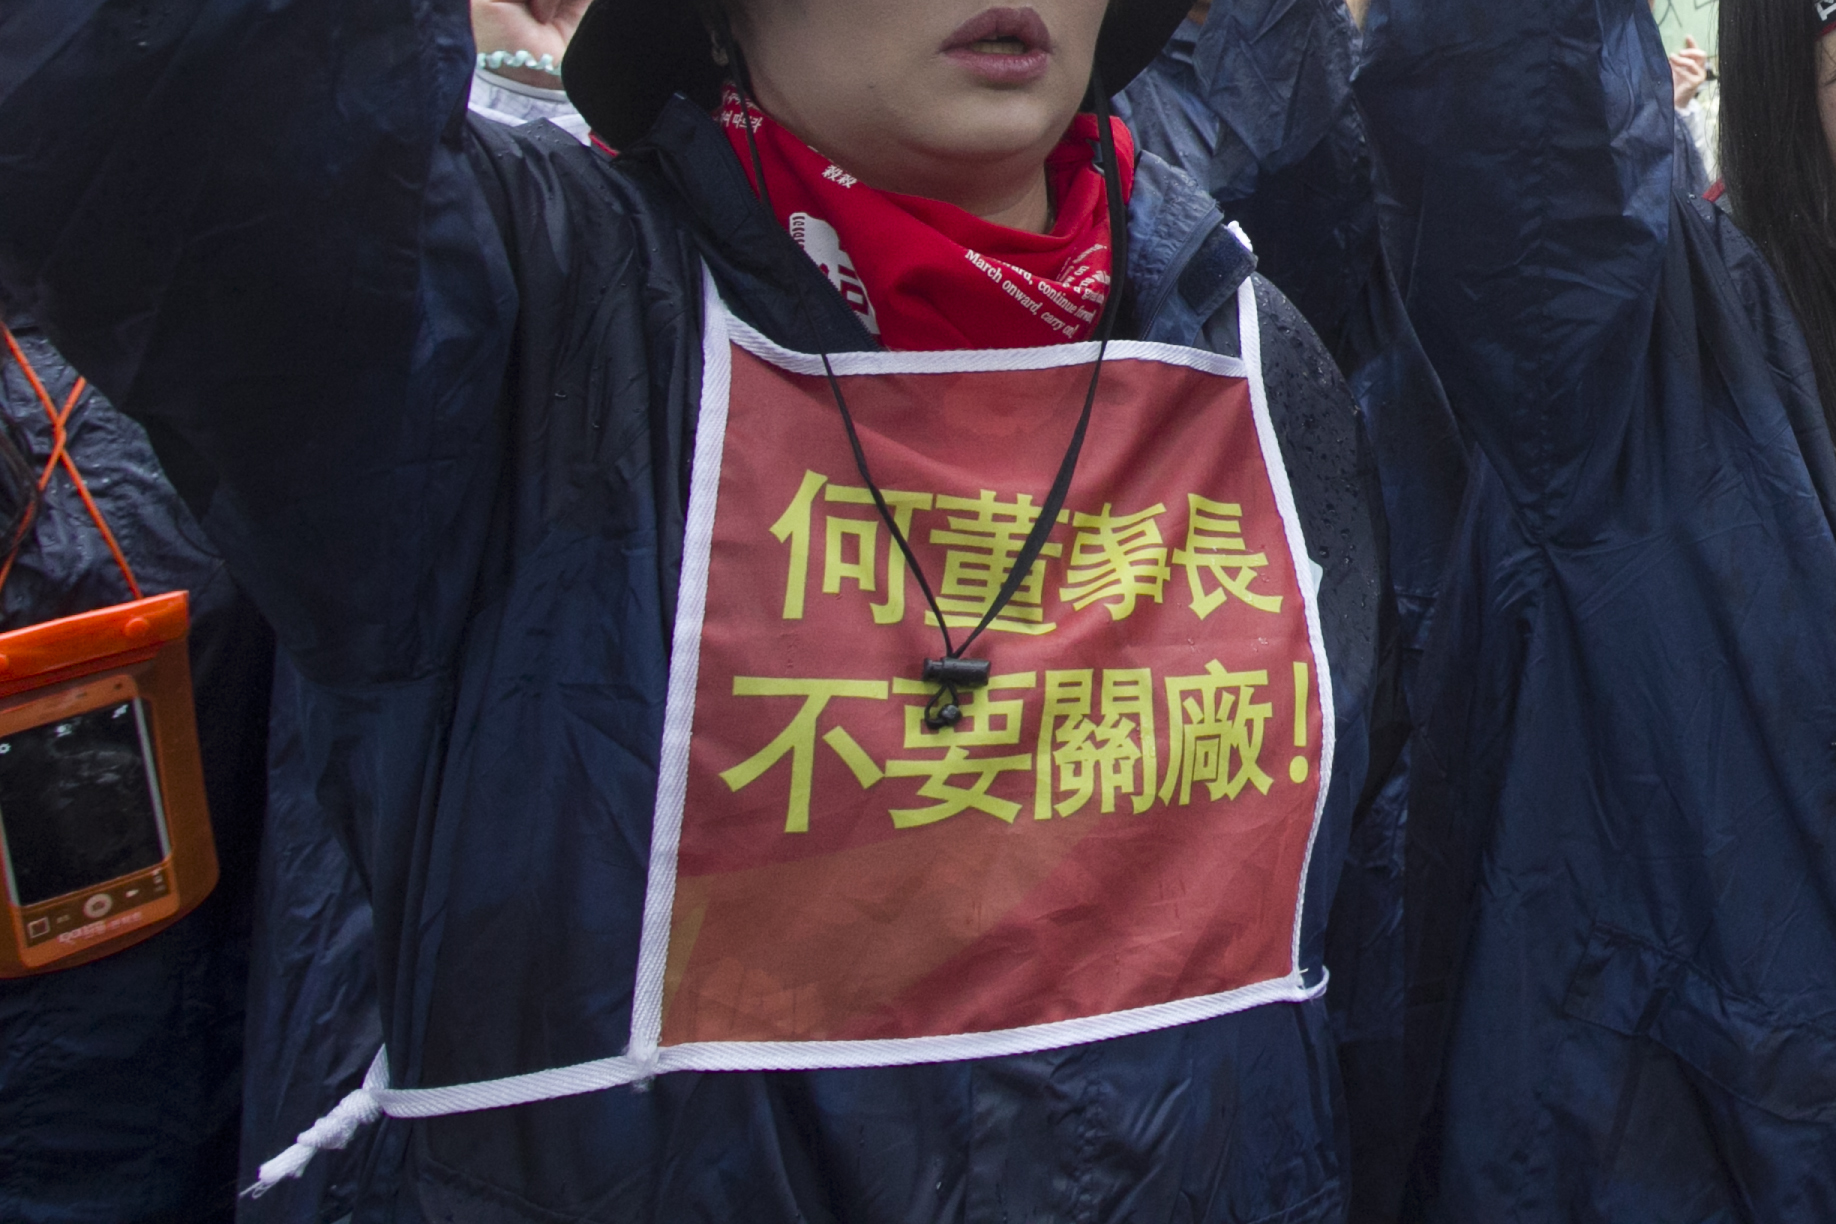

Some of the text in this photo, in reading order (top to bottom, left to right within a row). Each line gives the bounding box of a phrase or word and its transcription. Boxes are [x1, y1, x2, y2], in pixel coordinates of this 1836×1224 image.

[965, 248, 1003, 283] March
[1001, 279, 1044, 316] onward,
[1040, 311, 1067, 331] carry
[769, 468, 1283, 636] 何董事長
[719, 660, 1309, 834] 不要關廠!
